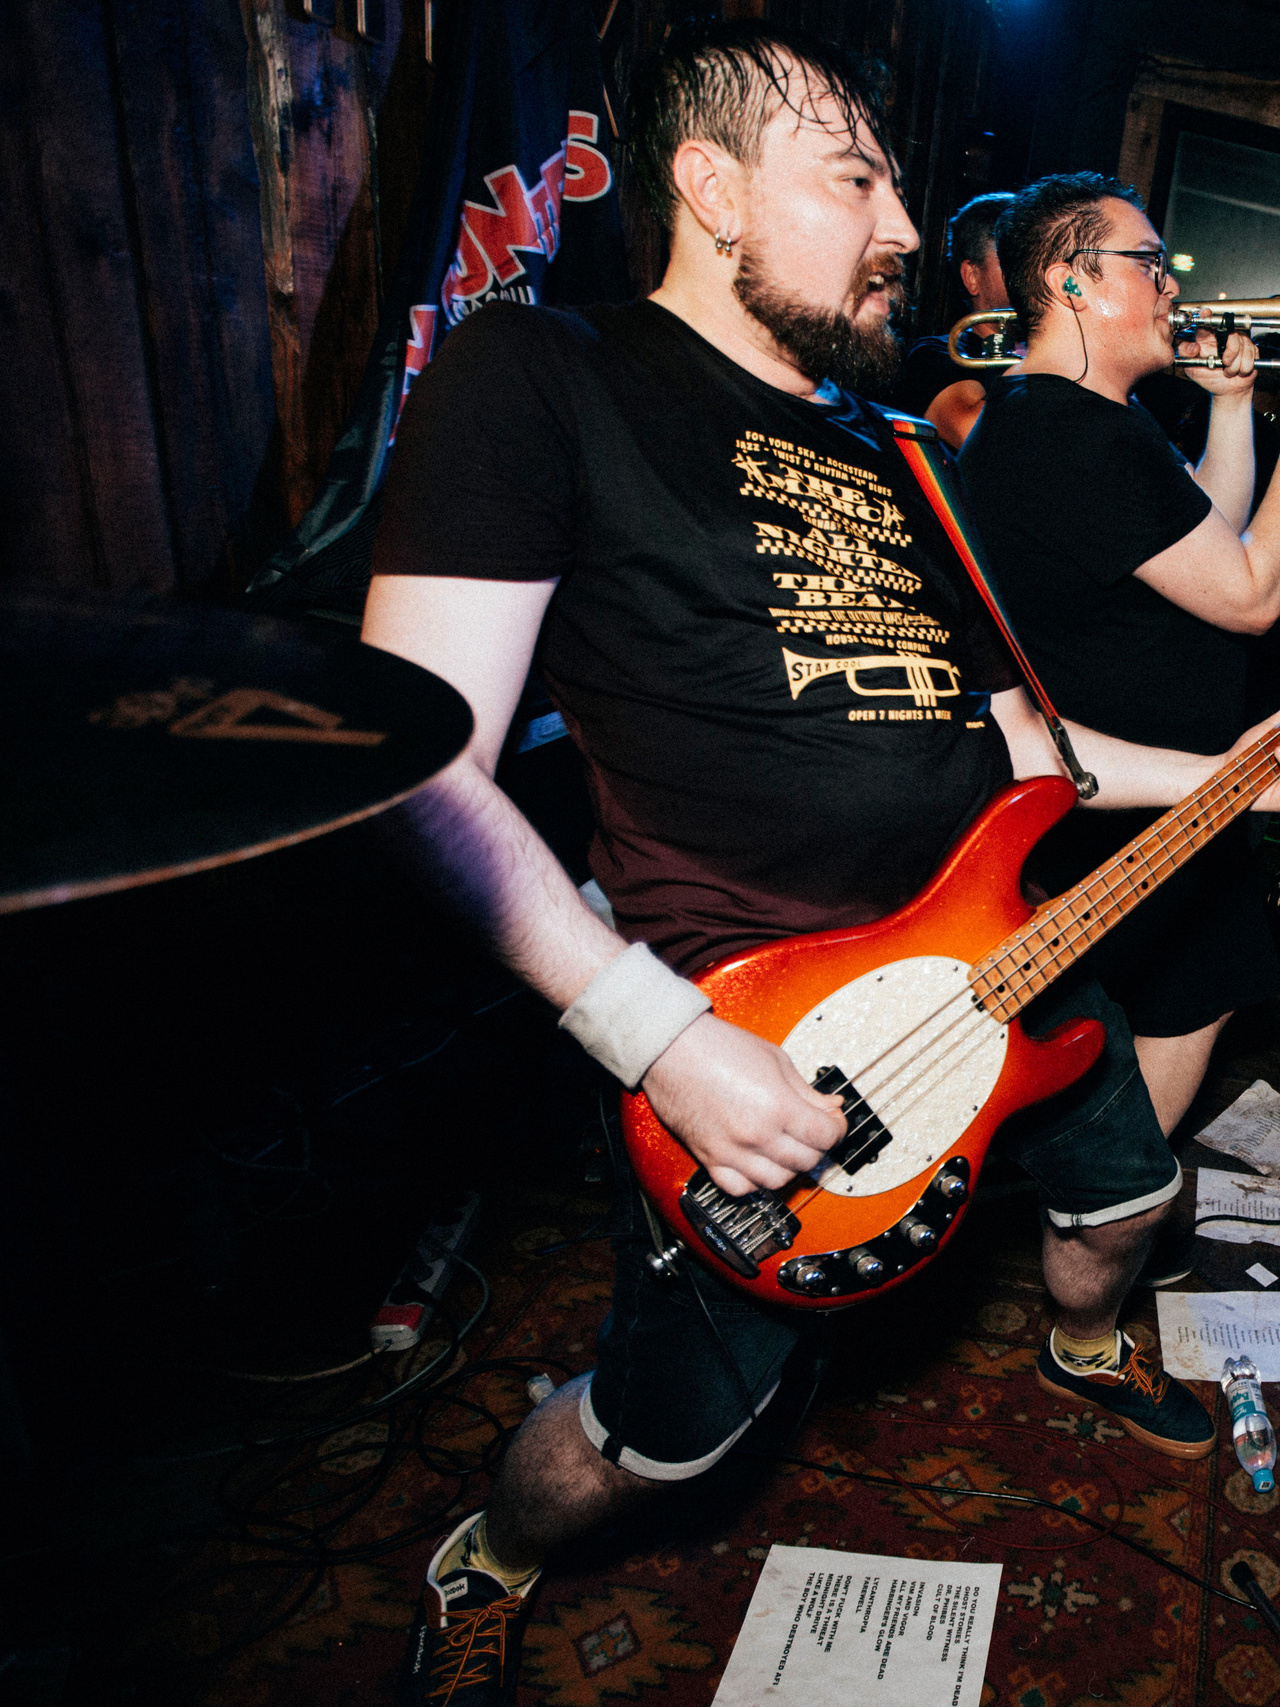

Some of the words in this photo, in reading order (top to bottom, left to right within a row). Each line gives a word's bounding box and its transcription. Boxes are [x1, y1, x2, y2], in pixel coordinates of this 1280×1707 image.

[745, 430, 765, 442] FOR
[768, 437, 794, 452] YOUR
[797, 447, 815, 460] SKA
[827, 457, 878, 482] ROCKSTEADY
[736, 439, 760, 452] JAZZ
[772, 448, 801, 465] TWIST
[803, 459, 811, 468] &
[813, 463, 849, 481] RHYTHM
[868, 482, 892, 497] BLUES
[779, 463, 867, 505] THE
[807, 527, 877, 555] ALL
[887, 639, 894, 648] &
[792, 661, 830, 681] STAY
[836, 660, 862, 668] COOL
[848, 710, 876, 721] OPEN
[879, 710, 885, 720] 7
[888, 710, 924, 721] NIGHTS
[925, 710, 933, 720] A
[934, 710, 952, 720] WEEK
[806, 1572, 816, 1586] THE
[814, 1572, 825, 1590] LIKE
[831, 1575, 844, 1598] THERE
[841, 1575, 853, 1596] DON'T
[899, 1580, 907, 1593] ALL
[908, 1581, 917, 1595] VIM
[800, 1587, 811, 1603] BOY
[818, 1573, 834, 1610] MIDNIGHT
[855, 1577, 871, 1614] FAREWELL
[896, 1595, 904, 1606] MY
[912, 1581, 926, 1617] INVASION
[935, 1583, 944, 1602] CULT
[945, 1584, 953, 1596] DR.
[953, 1585, 962, 1599] THE
[961, 1586, 971, 1610] GHOST
[973, 1586, 980, 1597] DO
[794, 1604, 805, 1622] WHO
[806, 1597, 817, 1618] WOLF
[828, 1599, 836, 1607] IS
[834, 1597, 846, 1618] FUCK
[860, 1577, 880, 1633] LYCANTHROPIA
[881, 1579, 899, 1628] HARBINGER'S
[904, 1596, 913, 1611] AND
[932, 1604, 940, 1614] OF
[939, 1598, 951, 1625] PHIBES
[969, 1599, 978, 1614] YOU
[810, 1610, 823, 1634] DRIVE
[887, 1607, 901, 1639] FRIENDS
[898, 1613, 909, 1636] VIGOR
[948, 1601, 959, 1628] SILENT
[816, 1615, 831, 1646] THREAT
[828, 1620, 840, 1640] WITH
[926, 1615, 937, 1641] BLOOD
[954, 1612, 966, 1644] STORIES
[964, 1615, 975, 1644] REALLY
[778, 1624, 799, 1671] DESTROYED
[824, 1641, 833, 1652] ME
[874, 1629, 886, 1652] GLOW
[882, 1640, 892, 1657] ARE
[941, 1629, 953, 1662] WITNESS
[959, 1646, 969, 1670] THINK
[772, 1672, 782, 1686] AFI
[877, 1658, 888, 1680] DEAD
[956, 1671, 964, 1683] I'M
[951, 1684, 962, 1707] DEAD
